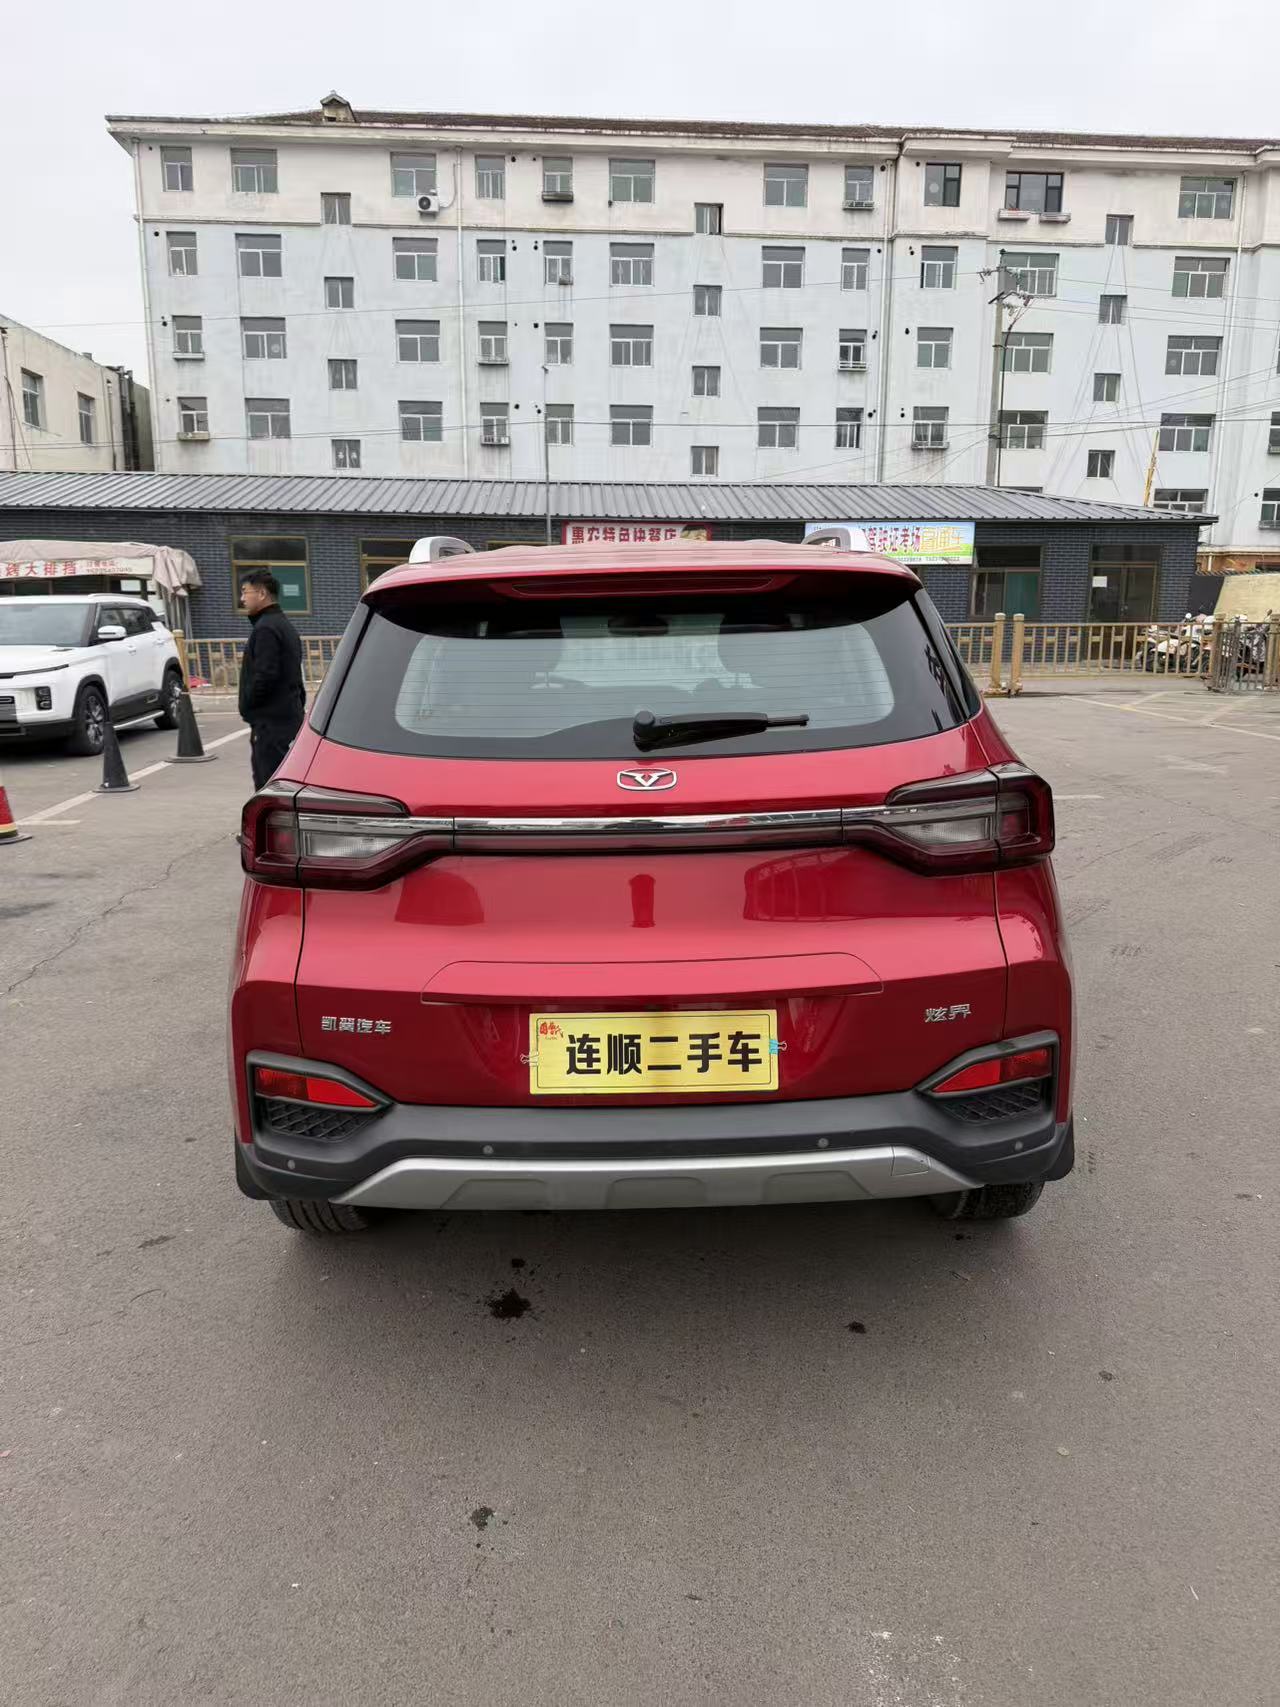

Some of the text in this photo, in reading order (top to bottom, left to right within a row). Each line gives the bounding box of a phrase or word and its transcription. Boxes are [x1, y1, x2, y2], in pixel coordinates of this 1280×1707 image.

[571, 526, 677, 544] 惠农特色快餐店
[925, 1003, 971, 1023] 炫界
[321, 1016, 392, 1034] 凯翼汽车
[566, 1031, 762, 1075] 连顺二手车
